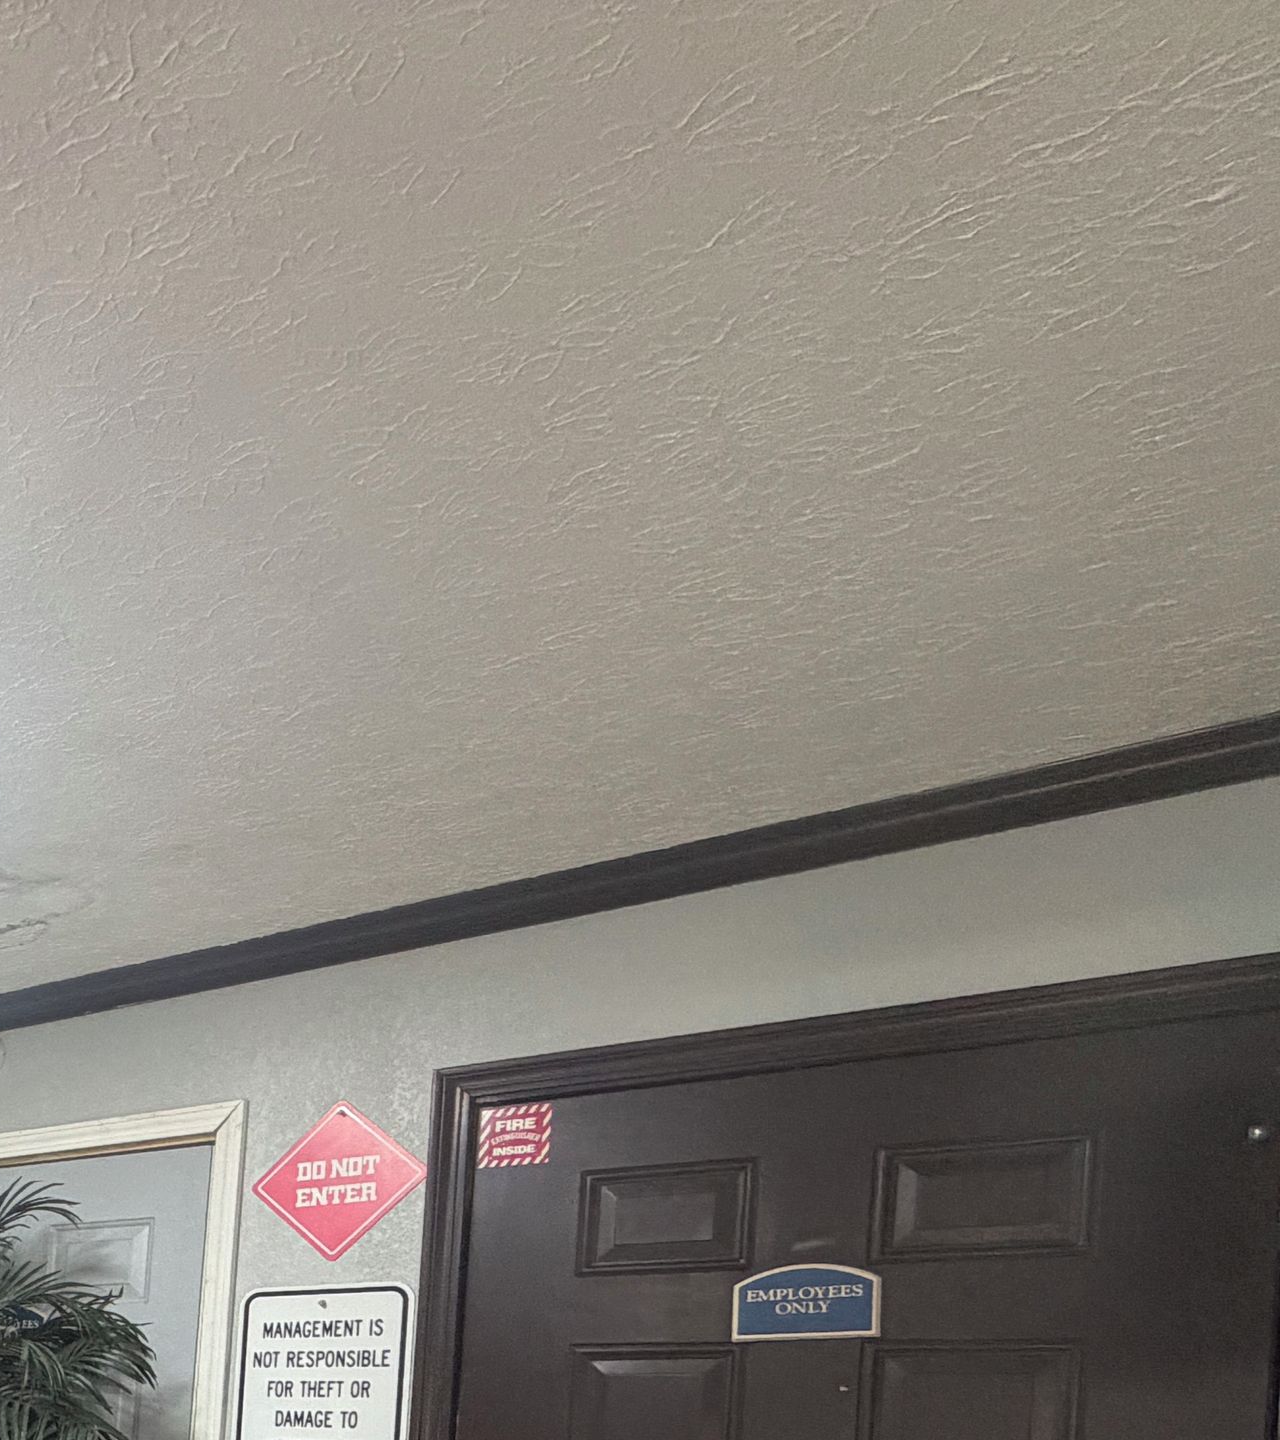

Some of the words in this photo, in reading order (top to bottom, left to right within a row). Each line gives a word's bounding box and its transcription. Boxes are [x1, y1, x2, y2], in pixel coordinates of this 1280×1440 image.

[495, 1117, 537, 1132] FIRE
[492, 1144, 537, 1156] INSIDE
[296, 1160, 326, 1182] DO
[329, 1155, 380, 1178] NOT
[295, 1182, 377, 1208] ENTER
[746, 1284, 863, 1302] EMPLOYEES
[775, 1300, 831, 1315] ONLY
[262, 1319, 363, 1339] MANAGEMENT
[369, 1318, 384, 1336] IS
[253, 1351, 280, 1368] NOT
[286, 1349, 391, 1368] RESPONSIBLE
[267, 1381, 294, 1398] FOR
[300, 1381, 344, 1398] THEFT
[350, 1381, 371, 1398] OR
[274, 1410, 334, 1428] DAMAGE
[340, 1411, 358, 1429] TO
